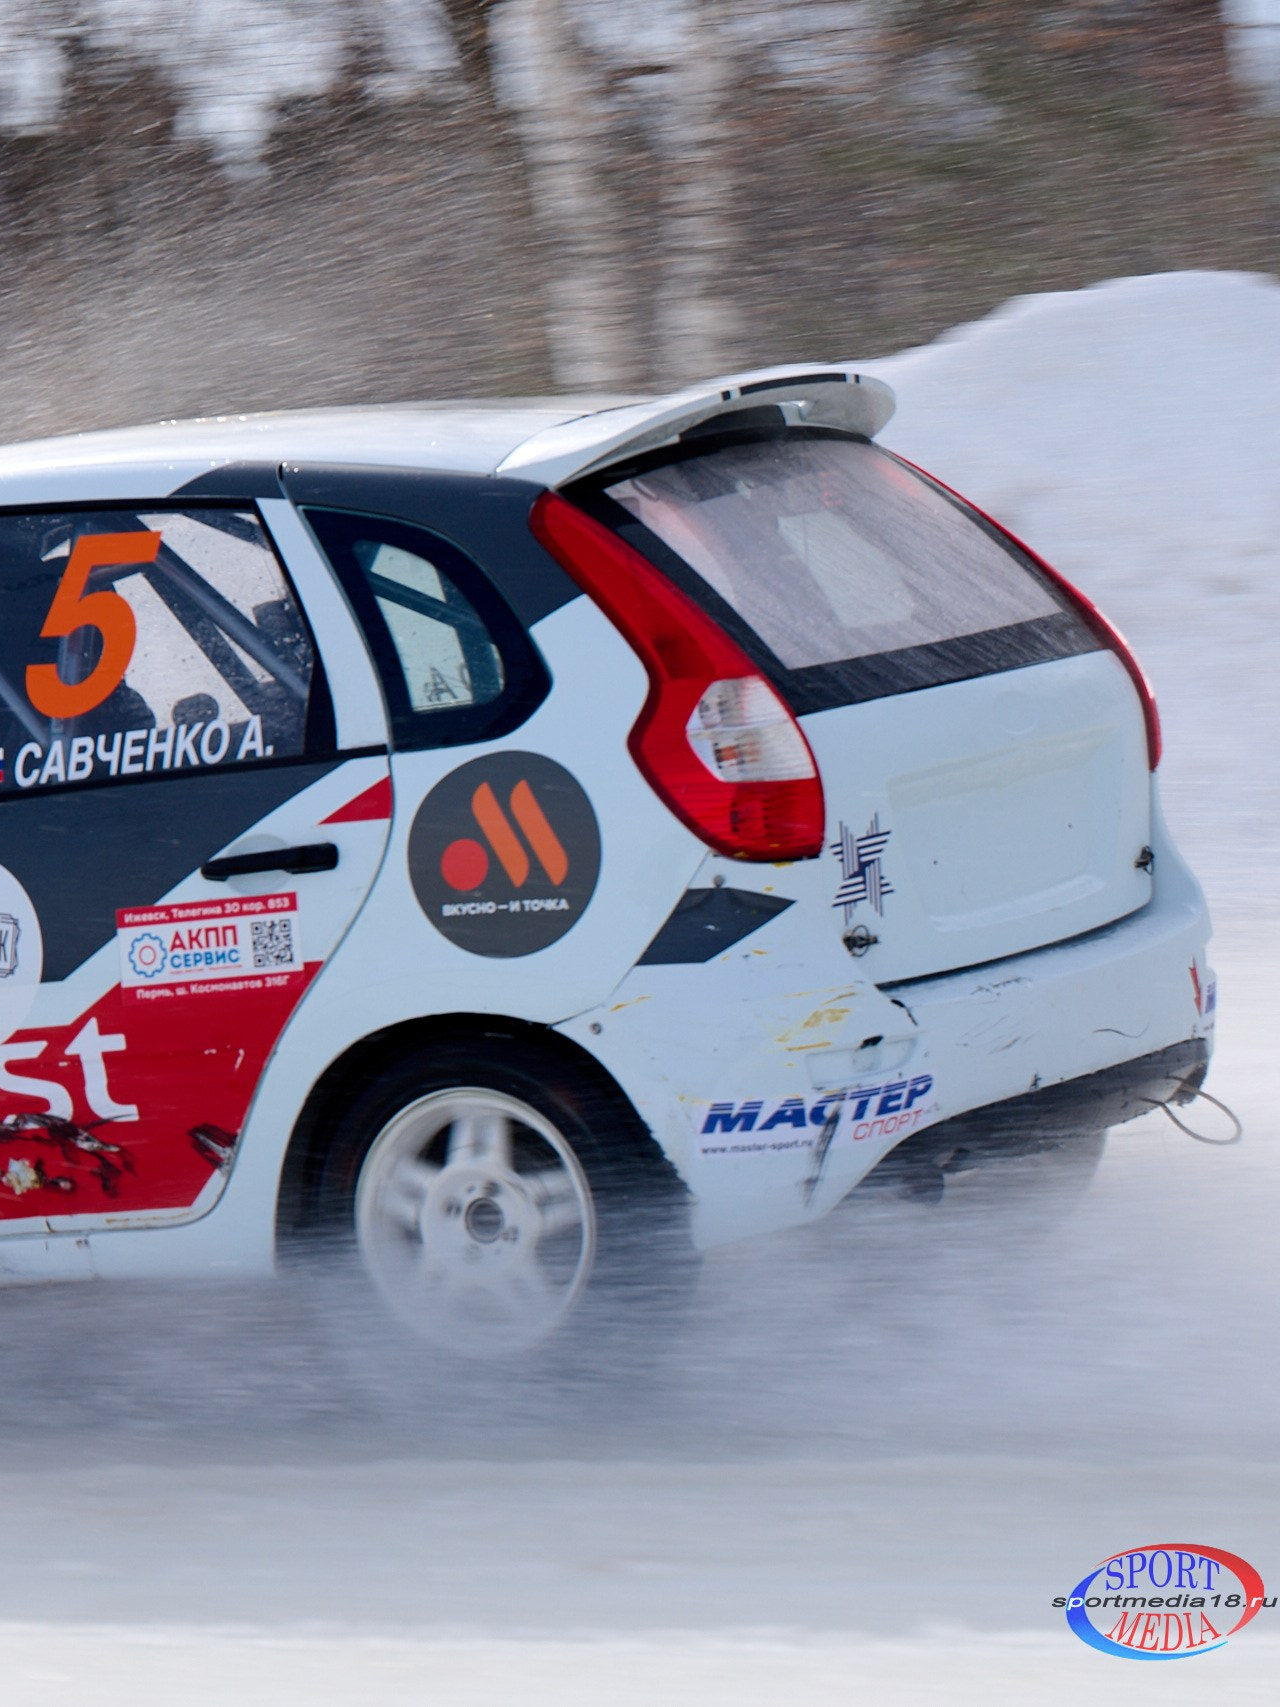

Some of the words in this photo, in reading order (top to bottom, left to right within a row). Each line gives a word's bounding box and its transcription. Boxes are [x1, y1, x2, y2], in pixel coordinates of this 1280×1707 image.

[25, 530, 163, 719] 5
[14, 718, 231, 788] САВЧЕНКО
[237, 714, 275, 759] А.
[442, 901, 497, 917] ВКУСНО
[523, 898, 570, 913] ТОЧКА
[169, 925, 238, 953] АКПП
[170, 948, 240, 969] СЕРВИС
[700, 1073, 934, 1134] МАСТЕР
[852, 1108, 924, 1141] СПОРТ
